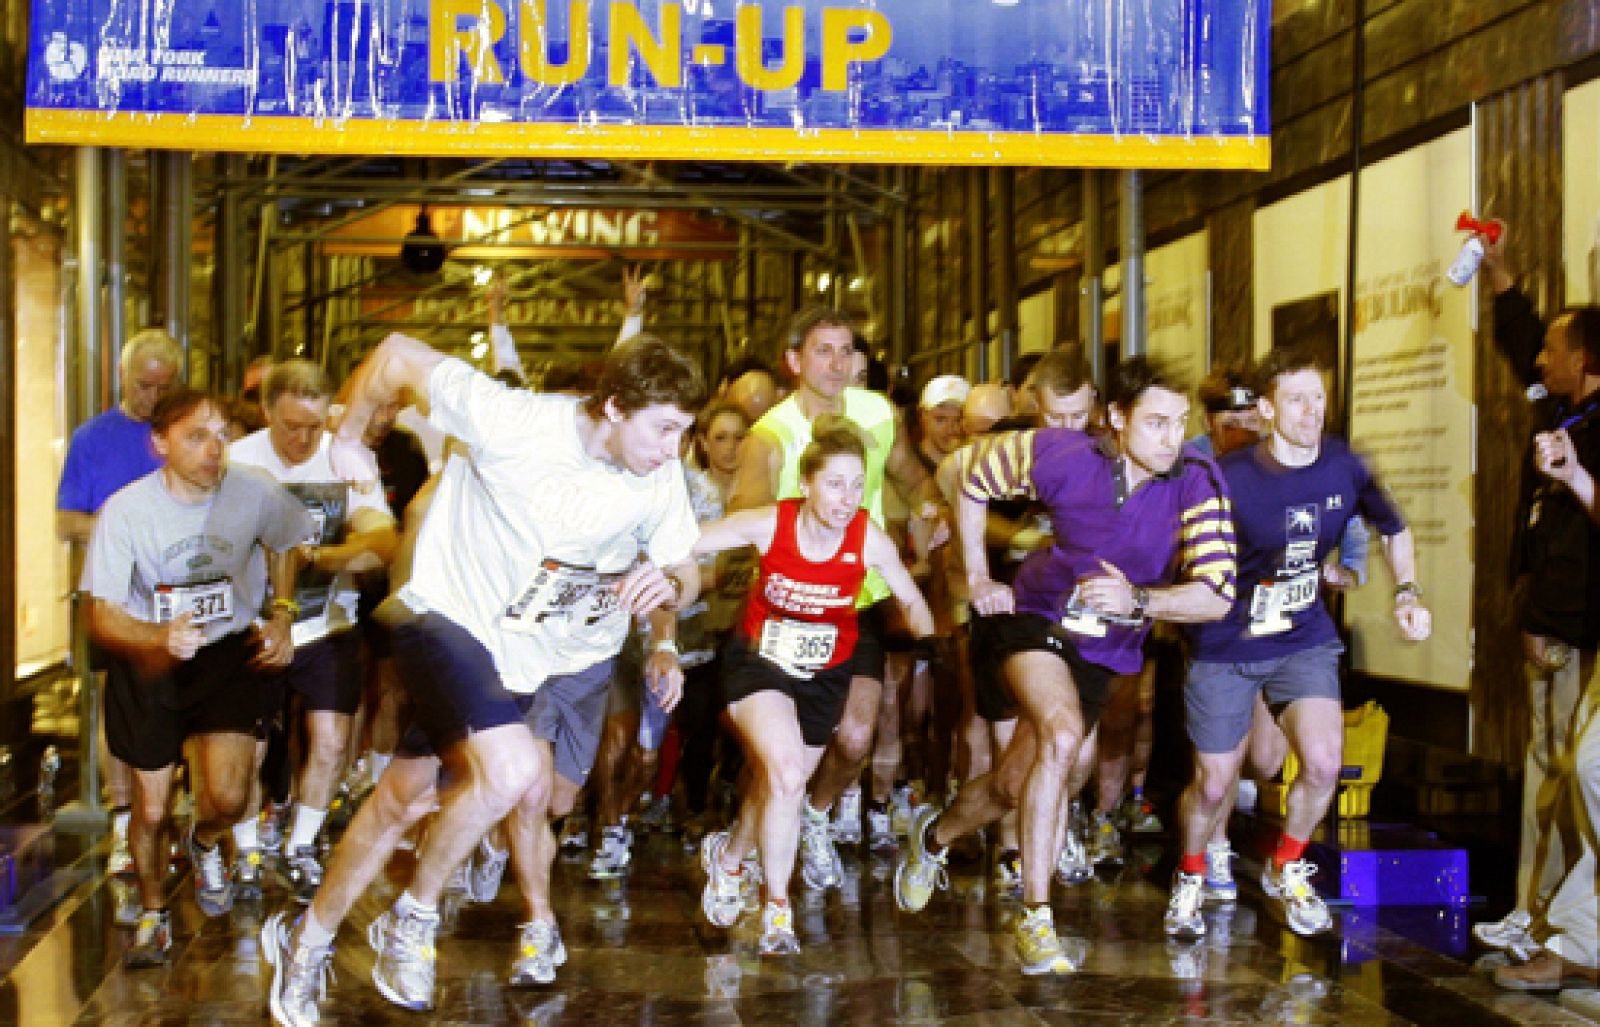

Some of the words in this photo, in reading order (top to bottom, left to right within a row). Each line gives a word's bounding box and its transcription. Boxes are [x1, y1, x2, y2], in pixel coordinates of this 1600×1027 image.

[152, 49, 206, 65] YORK
[428, 0, 893, 91] RUN-UP
[192, 591, 227, 618] 371
[793, 633, 833, 659] 365
